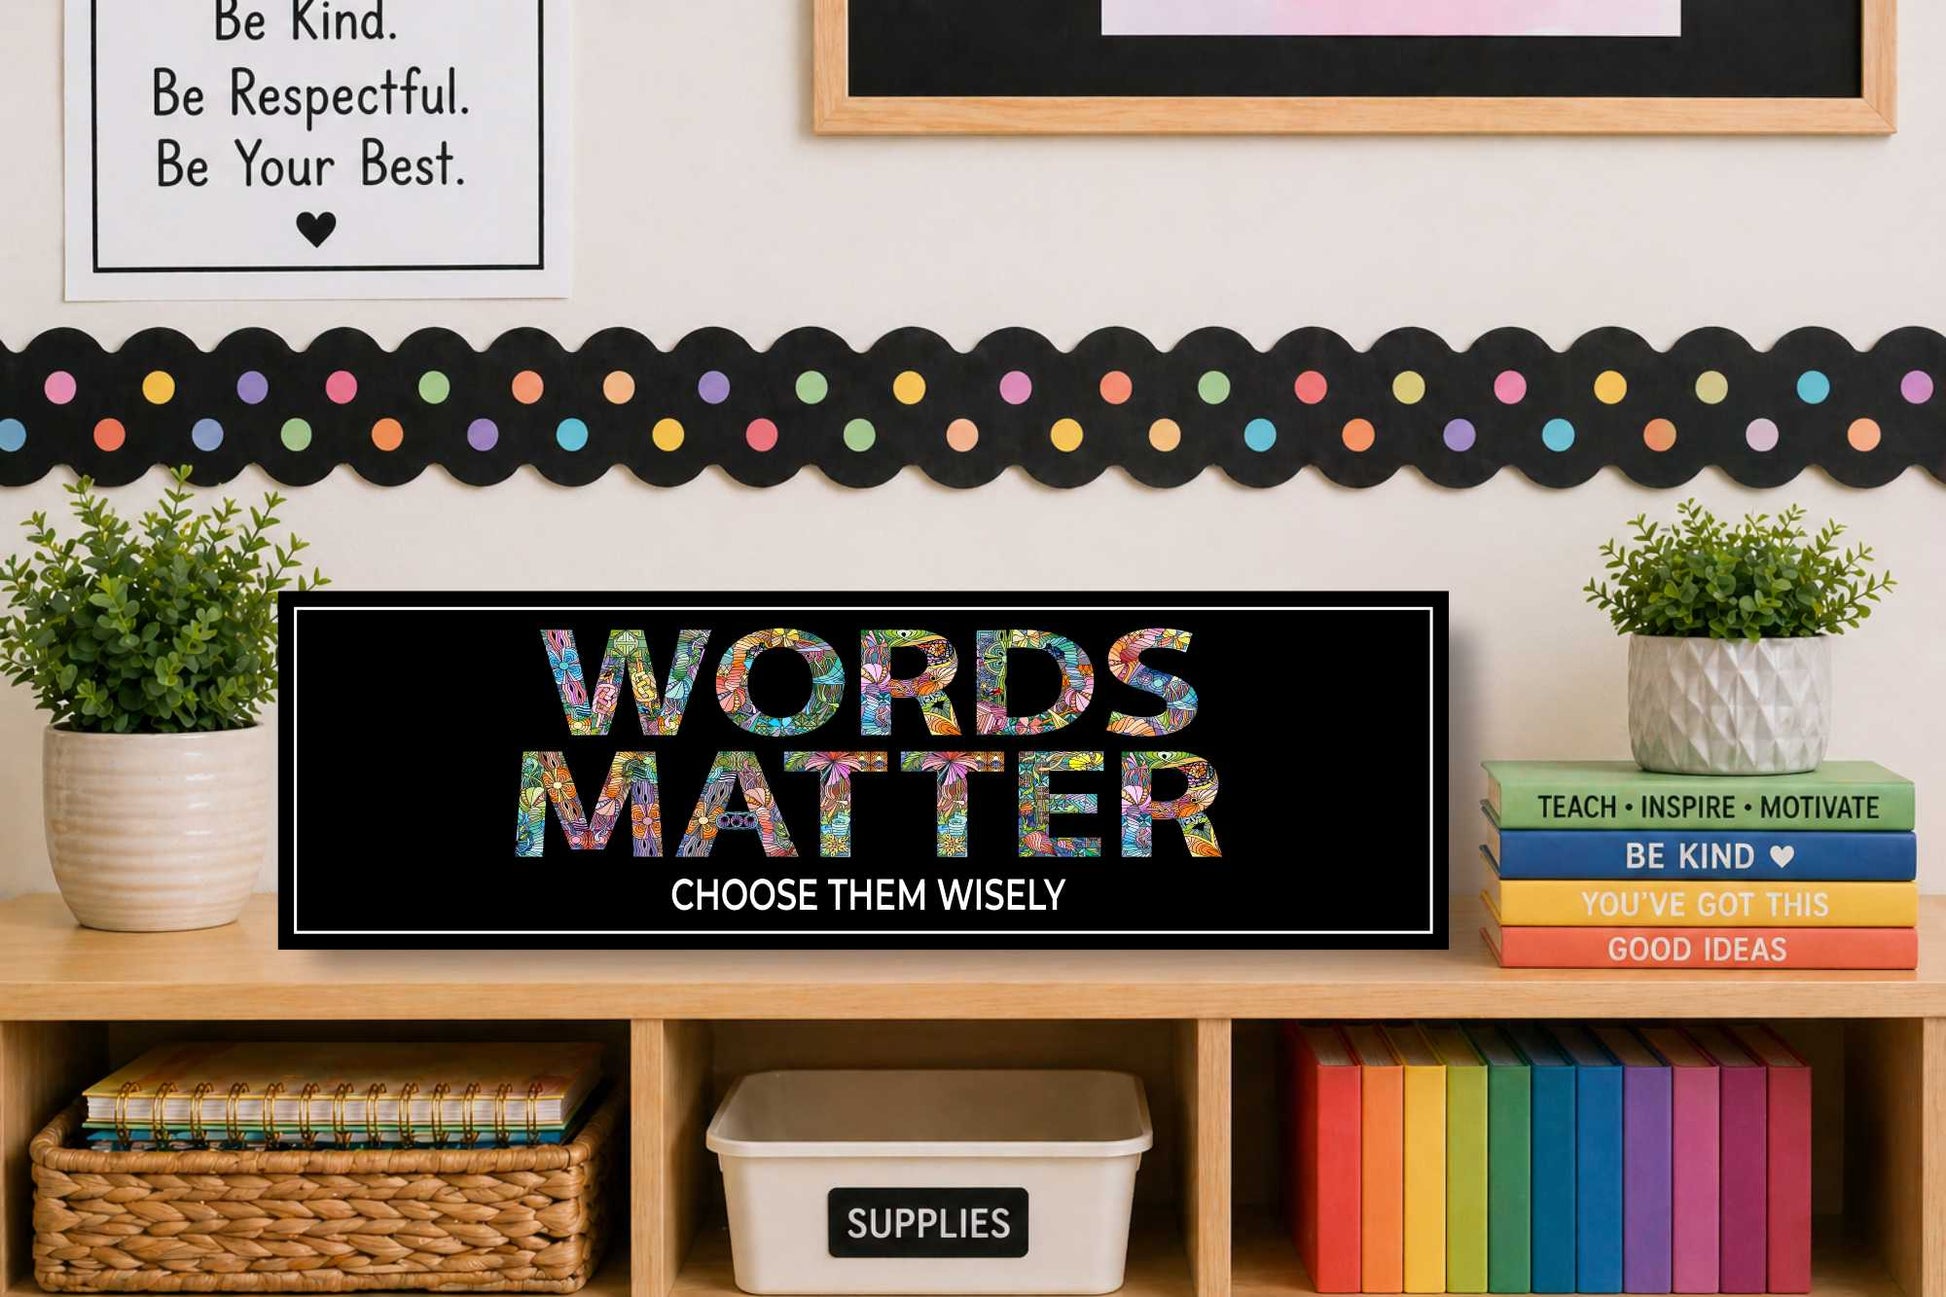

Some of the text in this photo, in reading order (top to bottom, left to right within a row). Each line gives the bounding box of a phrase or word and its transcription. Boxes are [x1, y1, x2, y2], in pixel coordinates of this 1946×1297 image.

[216, 0, 396, 40] Be Kind.
[154, 66, 468, 131] Be Respectful.
[158, 138, 463, 186] Be Your Best.
[541, 628, 1198, 737] WORDS
[515, 751, 1222, 857] MATTER
[1538, 795, 1879, 819] TEACH INSPIRE MOTIVATE
[1627, 843, 1754, 868] BE KIND
[672, 878, 1066, 911] CHOOSE THEM WISELY
[1583, 892, 1828, 916] YOU'VE GOT THIS
[1609, 937, 1786, 961] GOOD IDEAS
[848, 1208, 1010, 1238] SUPPLIES
